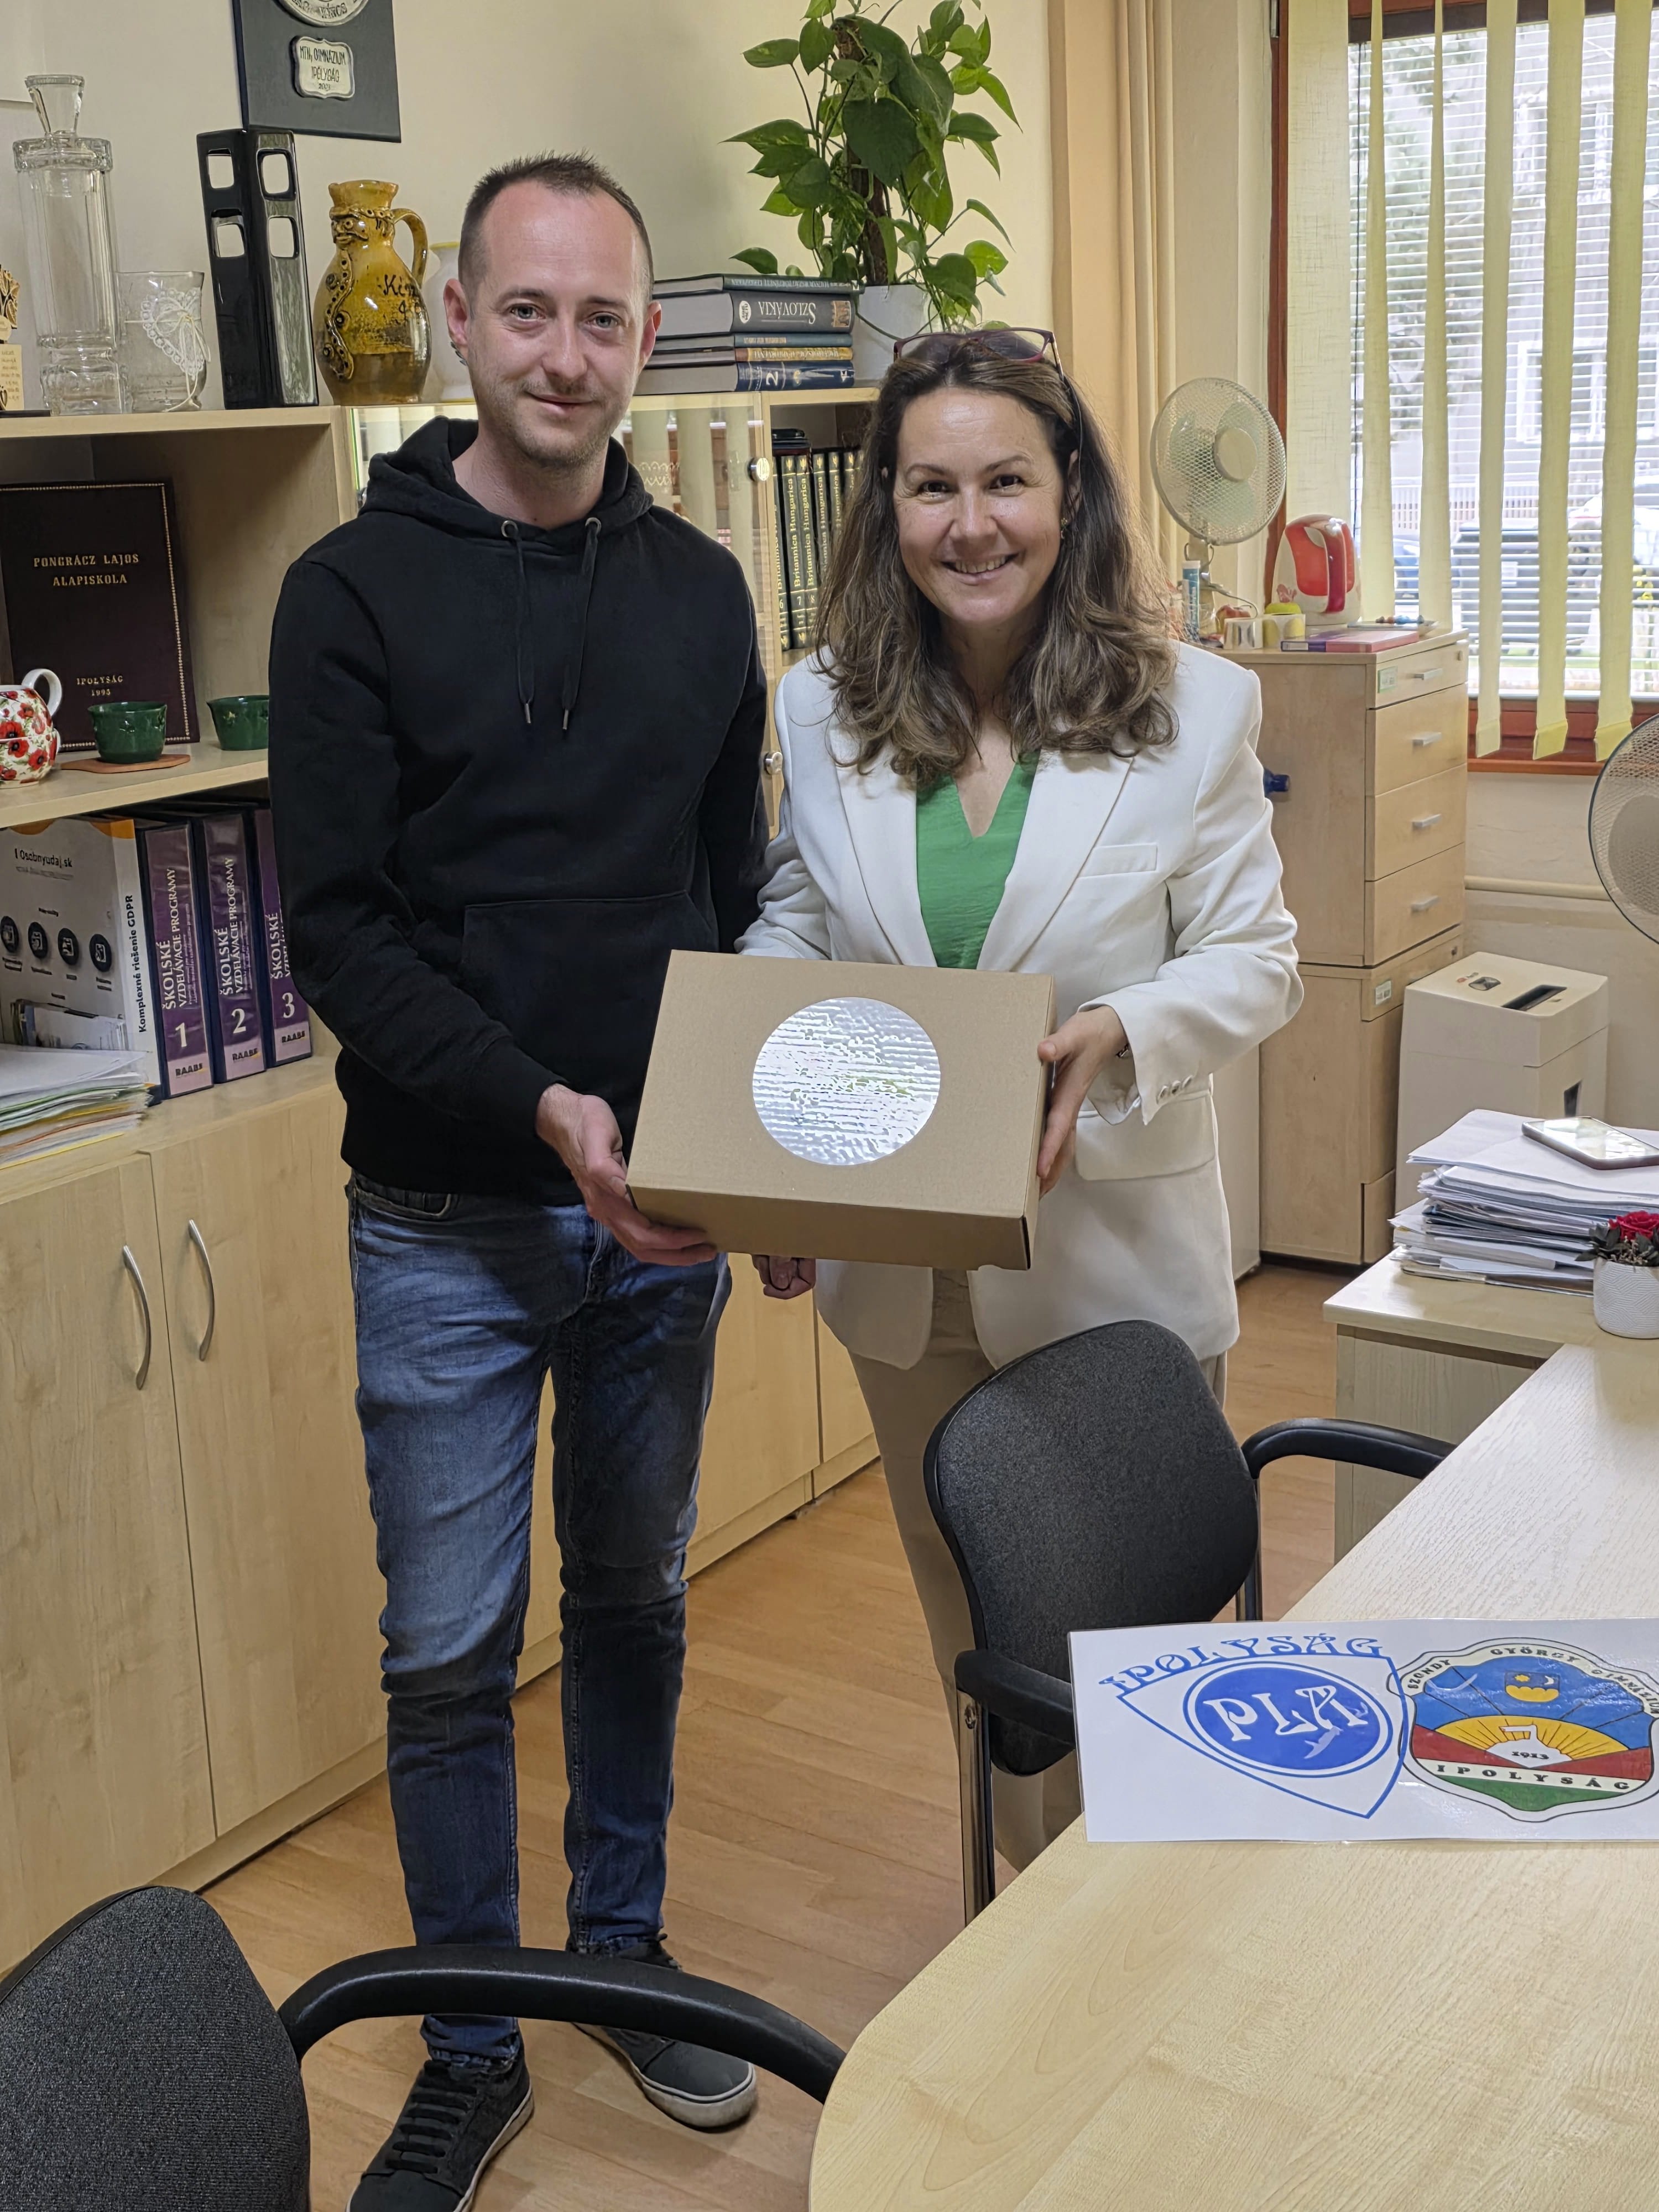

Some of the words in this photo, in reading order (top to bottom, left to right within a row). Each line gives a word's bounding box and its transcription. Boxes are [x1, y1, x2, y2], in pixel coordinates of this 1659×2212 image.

[765, 371, 779, 386] 2
[787, 478, 797, 532] Hungarica
[801, 478, 810, 531] Hungarica
[34, 555, 96, 567] PONGRÁCZ
[104, 554, 139, 565] LAJOS
[53, 574, 127, 586] ALAPISKOLA
[791, 534, 801, 588] Britannica
[805, 533, 815, 586] Britannica
[779, 599, 784, 609] 6
[797, 596, 801, 606] 7
[126, 895, 135, 927] GDPR
[167, 869, 181, 932] PROGRAMY
[225, 858, 237, 920] PROGRAMY
[129, 930, 140, 971] riešenie
[214, 927, 233, 995] ŠKOLSKÉ
[229, 921, 244, 993] VZDELÁVACIE
[268, 912, 283, 979] ŠKOLSKÉ
[156, 940, 176, 1010] ŠKOLSKÉ
[173, 934, 187, 1007] VZDELÁVACIE
[133, 973, 146, 1033] Komplexné
[231, 1008, 246, 1034] 2
[282, 992, 295, 1019] 3
[175, 1022, 187, 1047] 1
[1098, 1633, 1383, 1694] IPOLYSÁG
[1407, 1658, 1452, 1689] SZONDY
[1490, 1646, 1581, 1662] GYÖRGY
[1437, 1764, 1630, 1790] IPOLYSÁG
[1511, 1751, 1550, 1760] 1913
